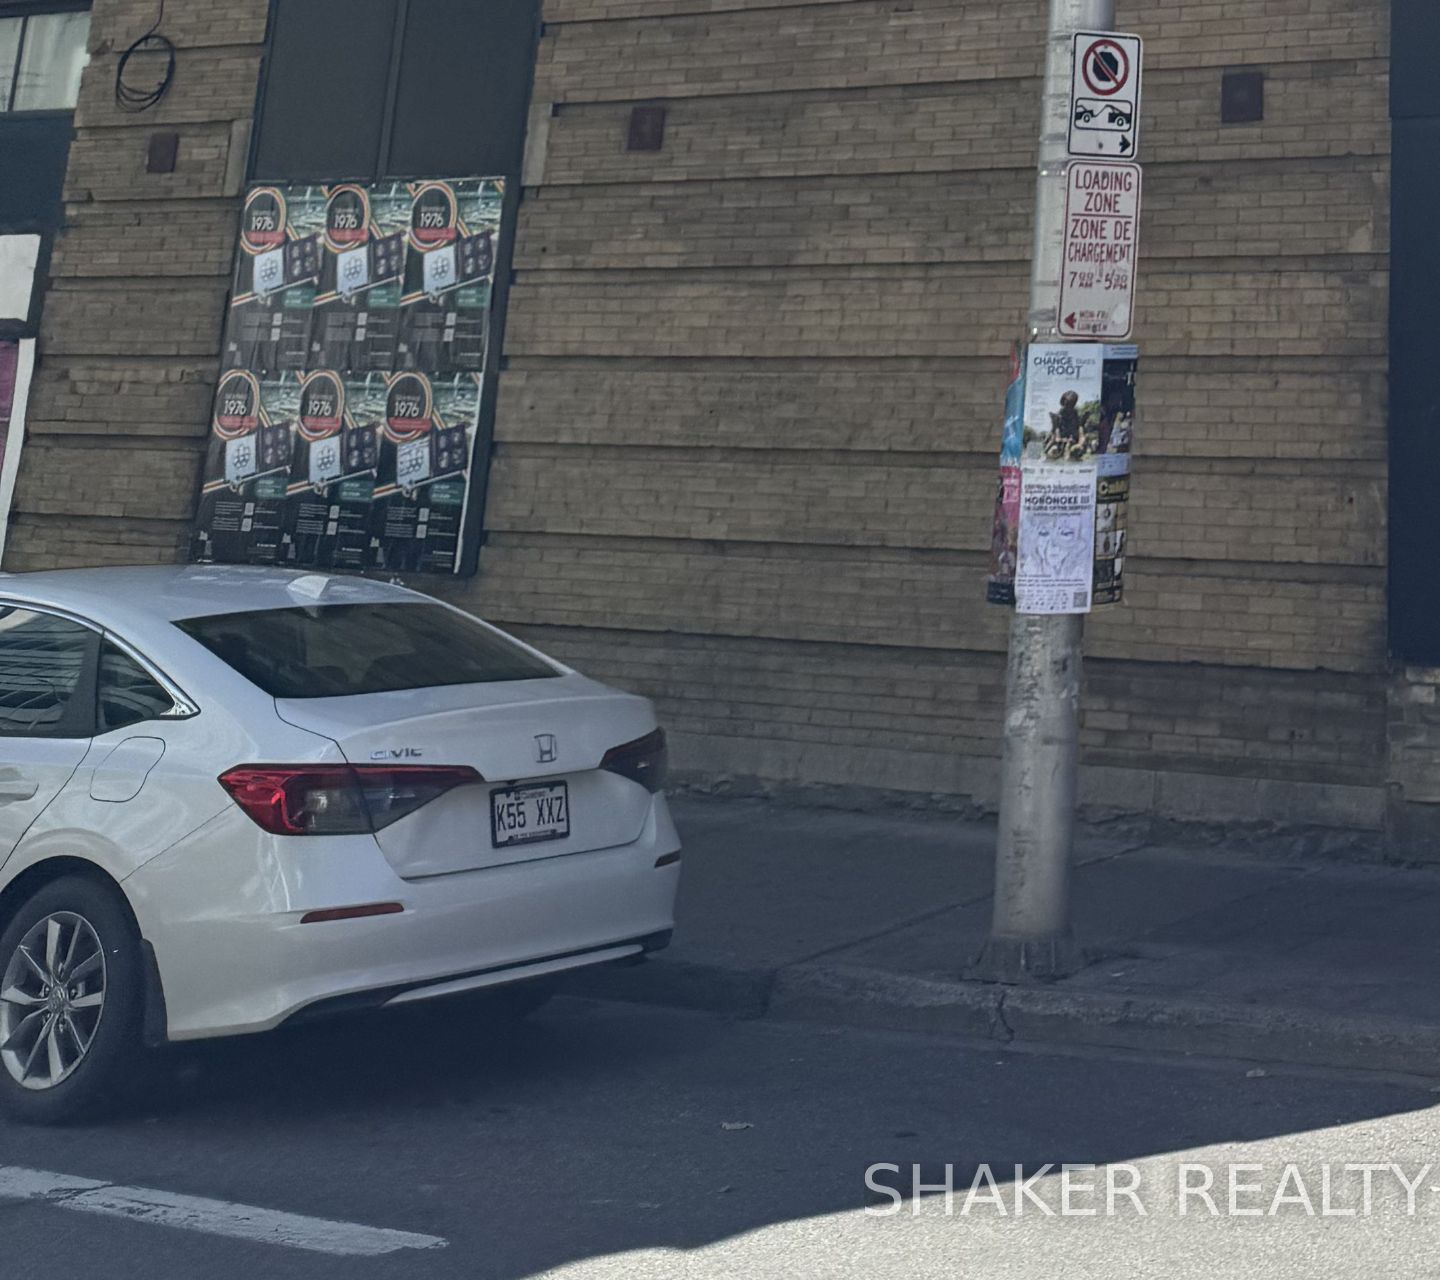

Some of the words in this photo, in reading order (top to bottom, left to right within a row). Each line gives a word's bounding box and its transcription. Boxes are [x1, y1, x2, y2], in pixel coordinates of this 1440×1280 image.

[1075, 169, 1132, 192] LOADING
[1084, 192, 1121, 213] ZONE
[252, 215, 275, 231] 1976
[334, 214, 358, 229] 1976
[420, 212, 444, 228] 1976
[1071, 218, 1108, 239] ZONE
[1114, 220, 1132, 240] DE
[1068, 242, 1132, 263] CHARGEMENT
[1033, 356, 1073, 366] CHANGE
[1047, 365, 1083, 379] ROOT
[224, 400, 247, 416] 1976
[308, 400, 332, 416] 1976
[394, 401, 419, 417] 1976
[370, 748, 423, 760] CIVIC
[497, 801, 526, 832] K55
[536, 795, 565, 826] XXZ
